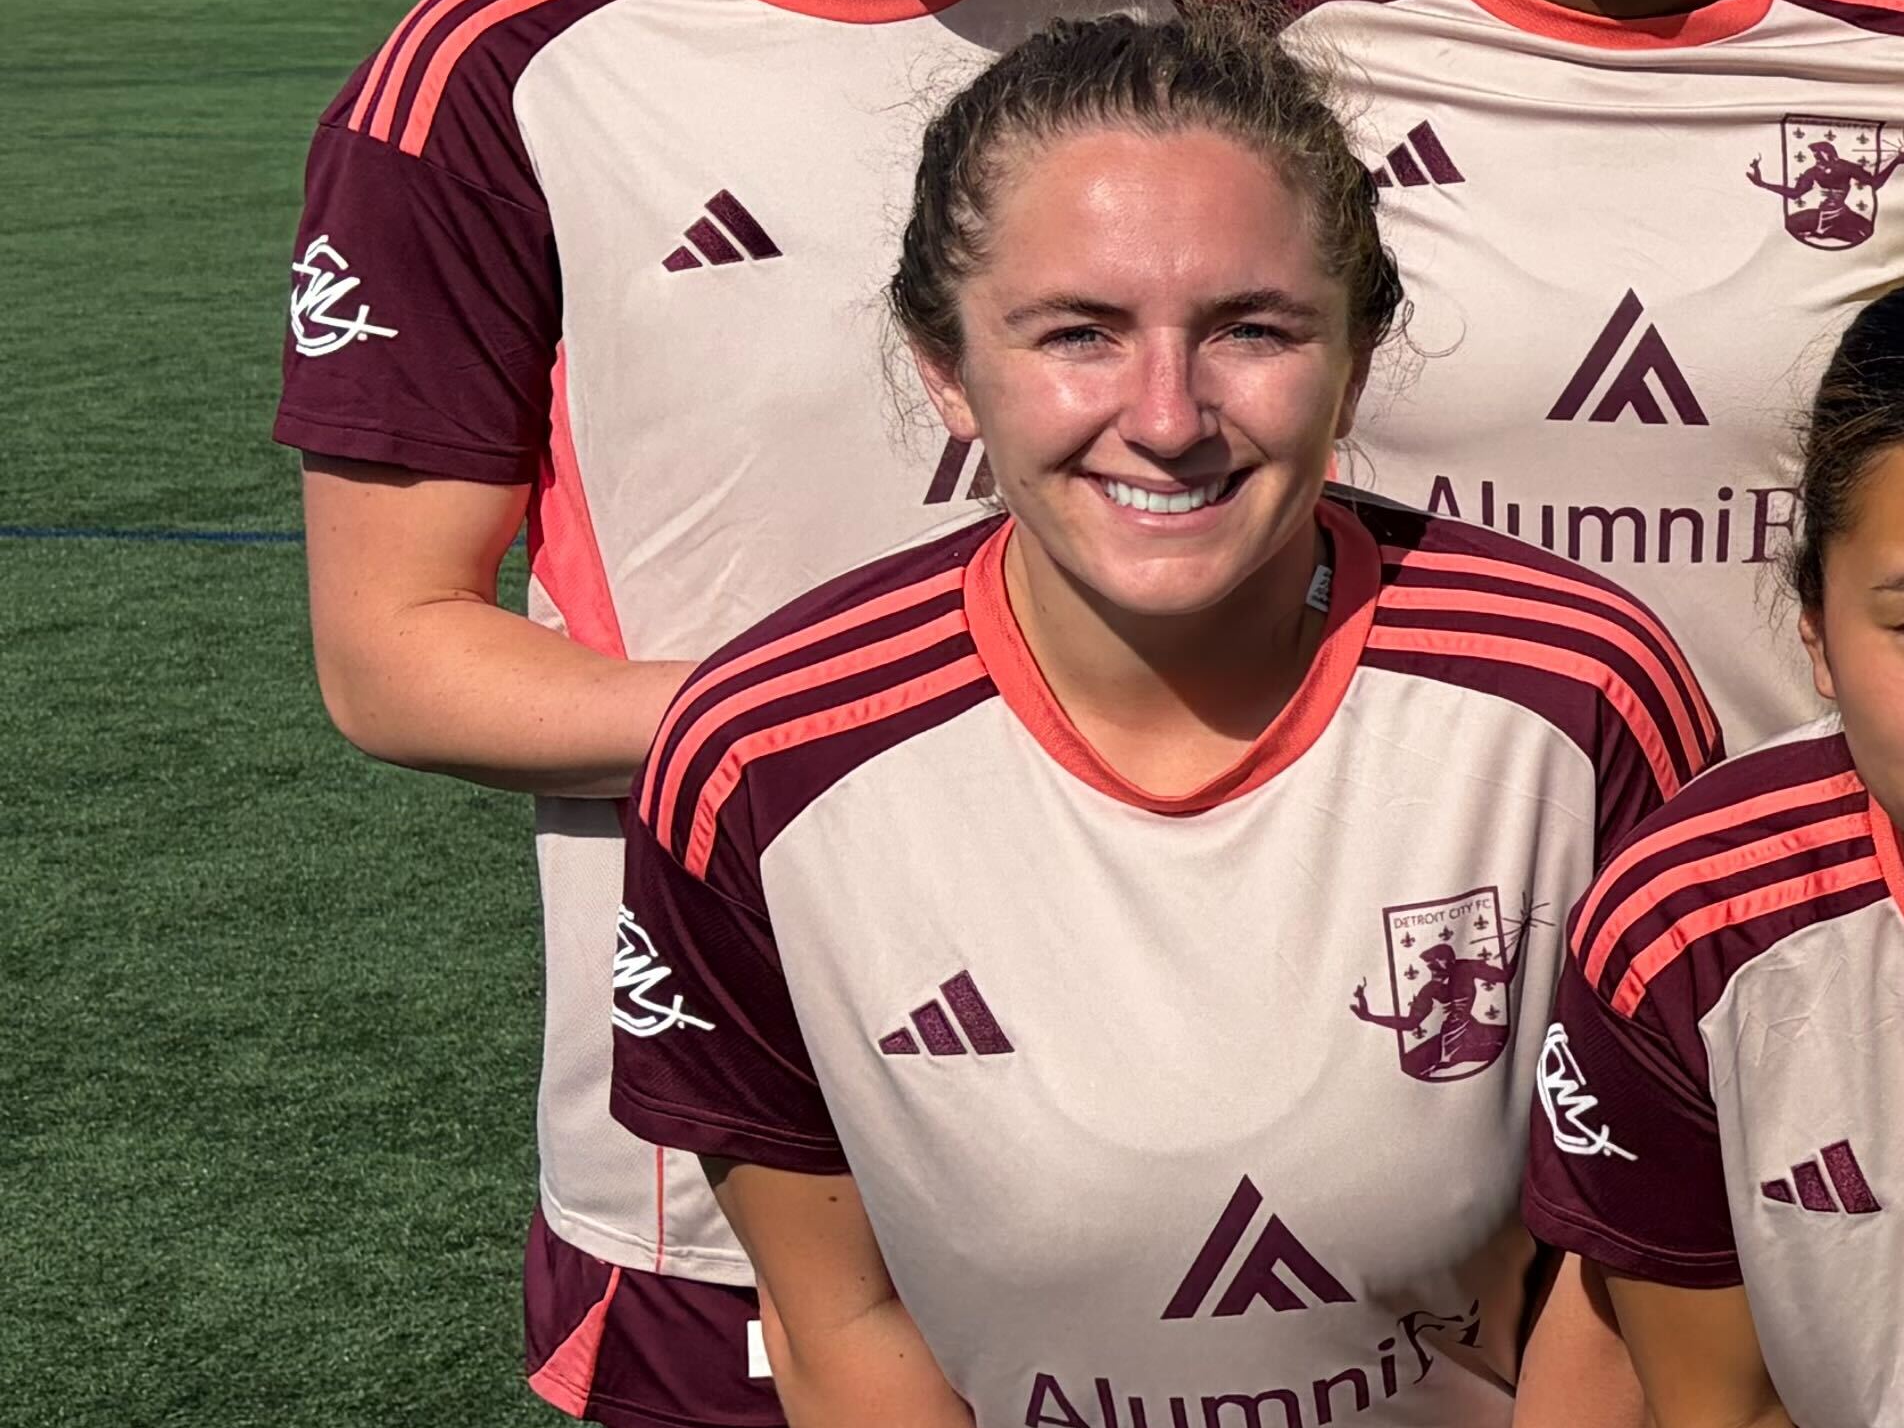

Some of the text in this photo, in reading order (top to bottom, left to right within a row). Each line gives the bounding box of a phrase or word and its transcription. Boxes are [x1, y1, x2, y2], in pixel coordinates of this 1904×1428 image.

[1427, 475, 1801, 563] AlumniF
[1393, 899, 1491, 929] DETROIT CITY FC
